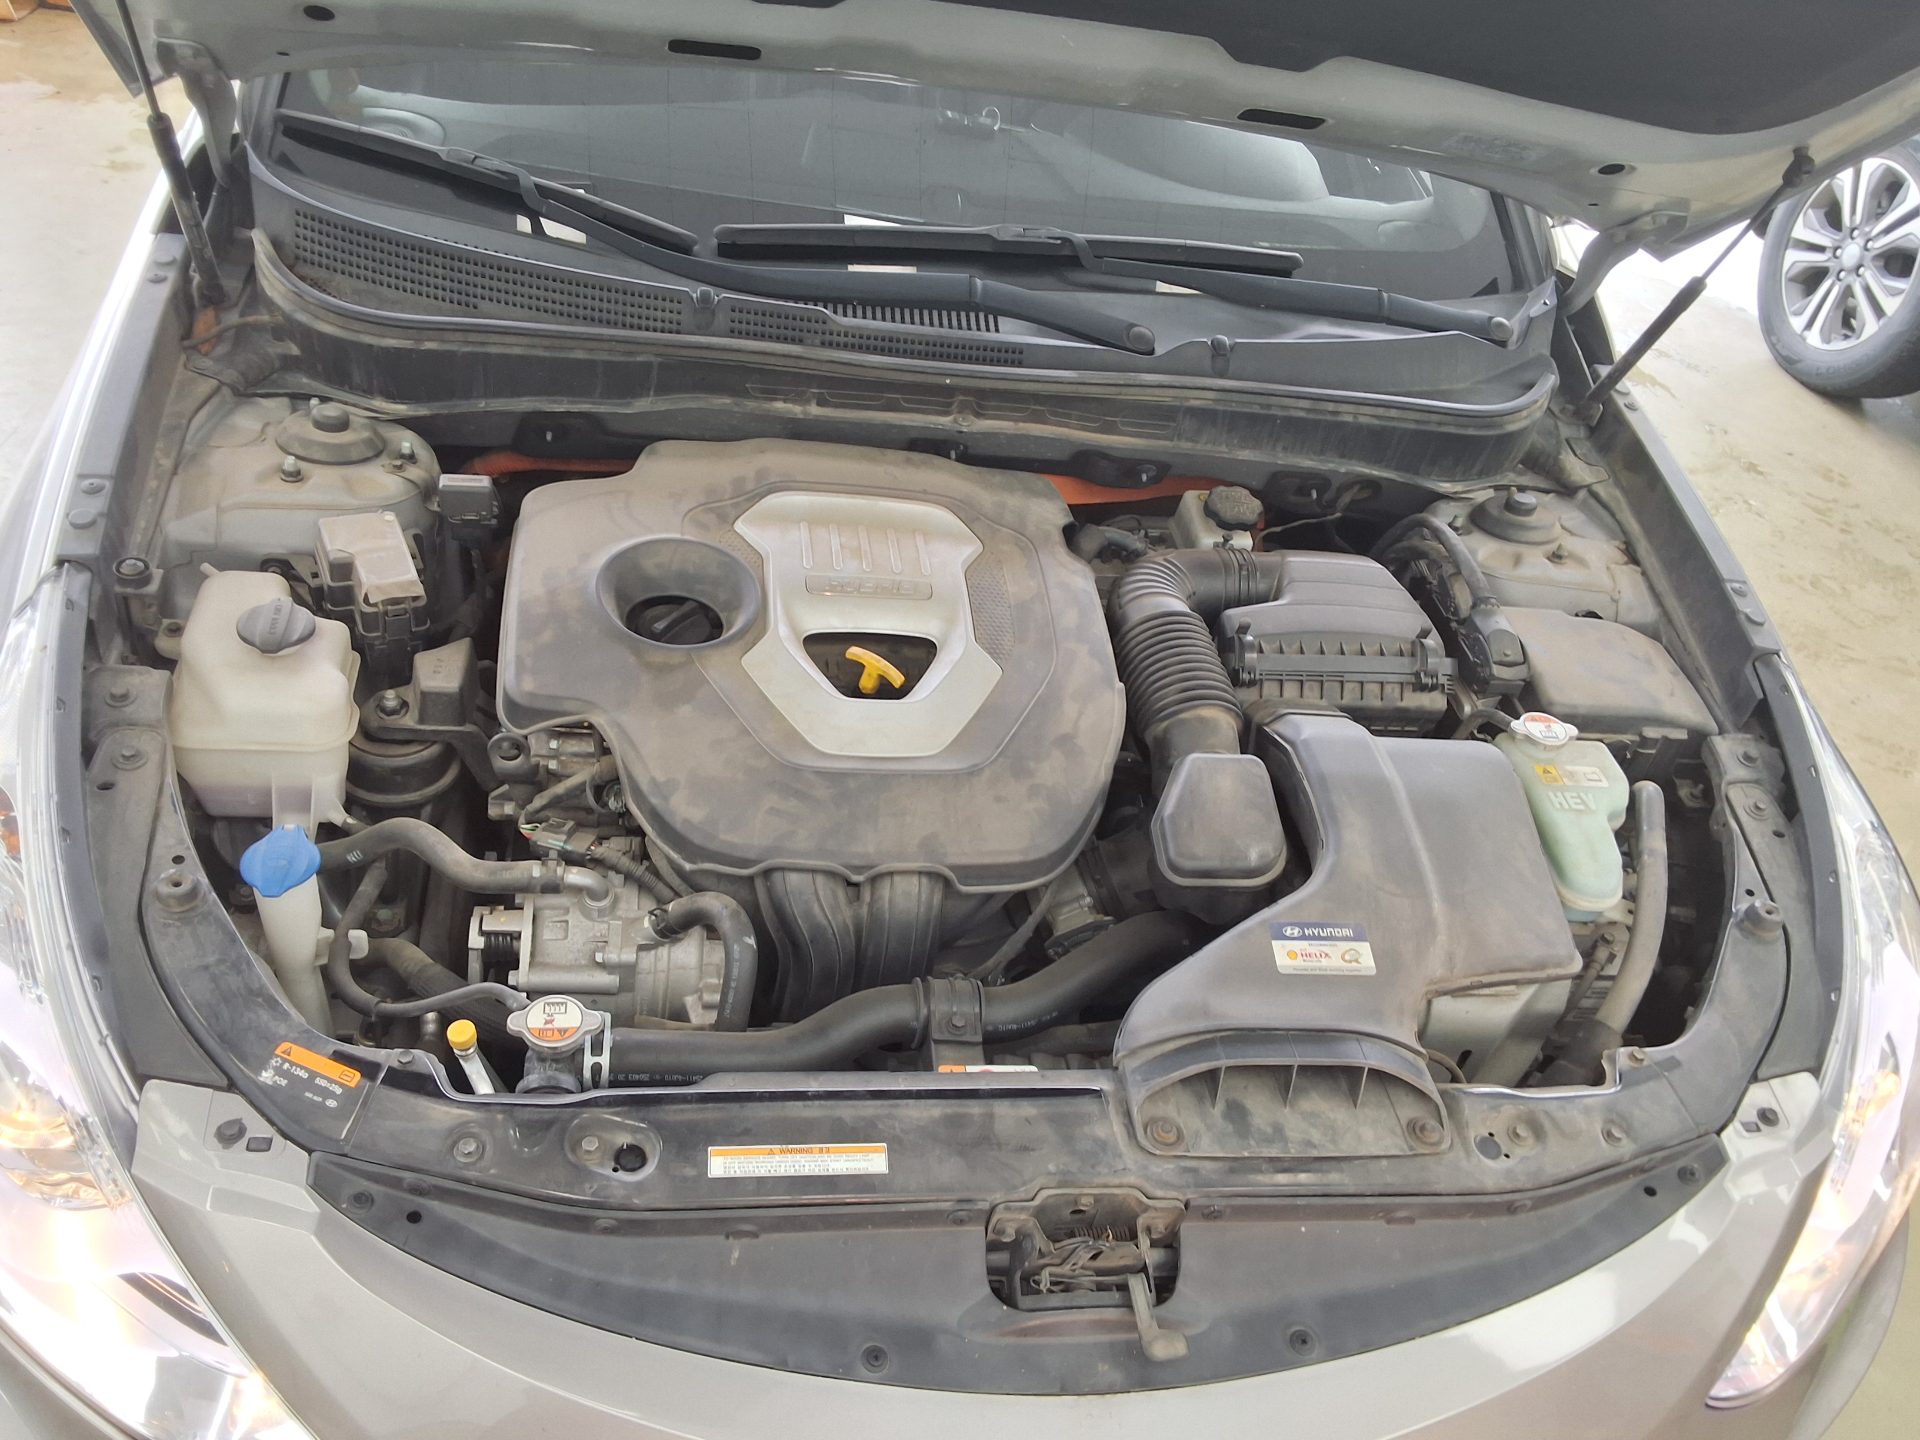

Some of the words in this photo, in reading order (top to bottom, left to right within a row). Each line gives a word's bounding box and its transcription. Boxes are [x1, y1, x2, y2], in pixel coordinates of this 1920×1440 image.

[1547, 791, 1597, 810] HEV
[1304, 926, 1354, 938] HYUNDAI
[779, 1146, 813, 1155] WARNING
